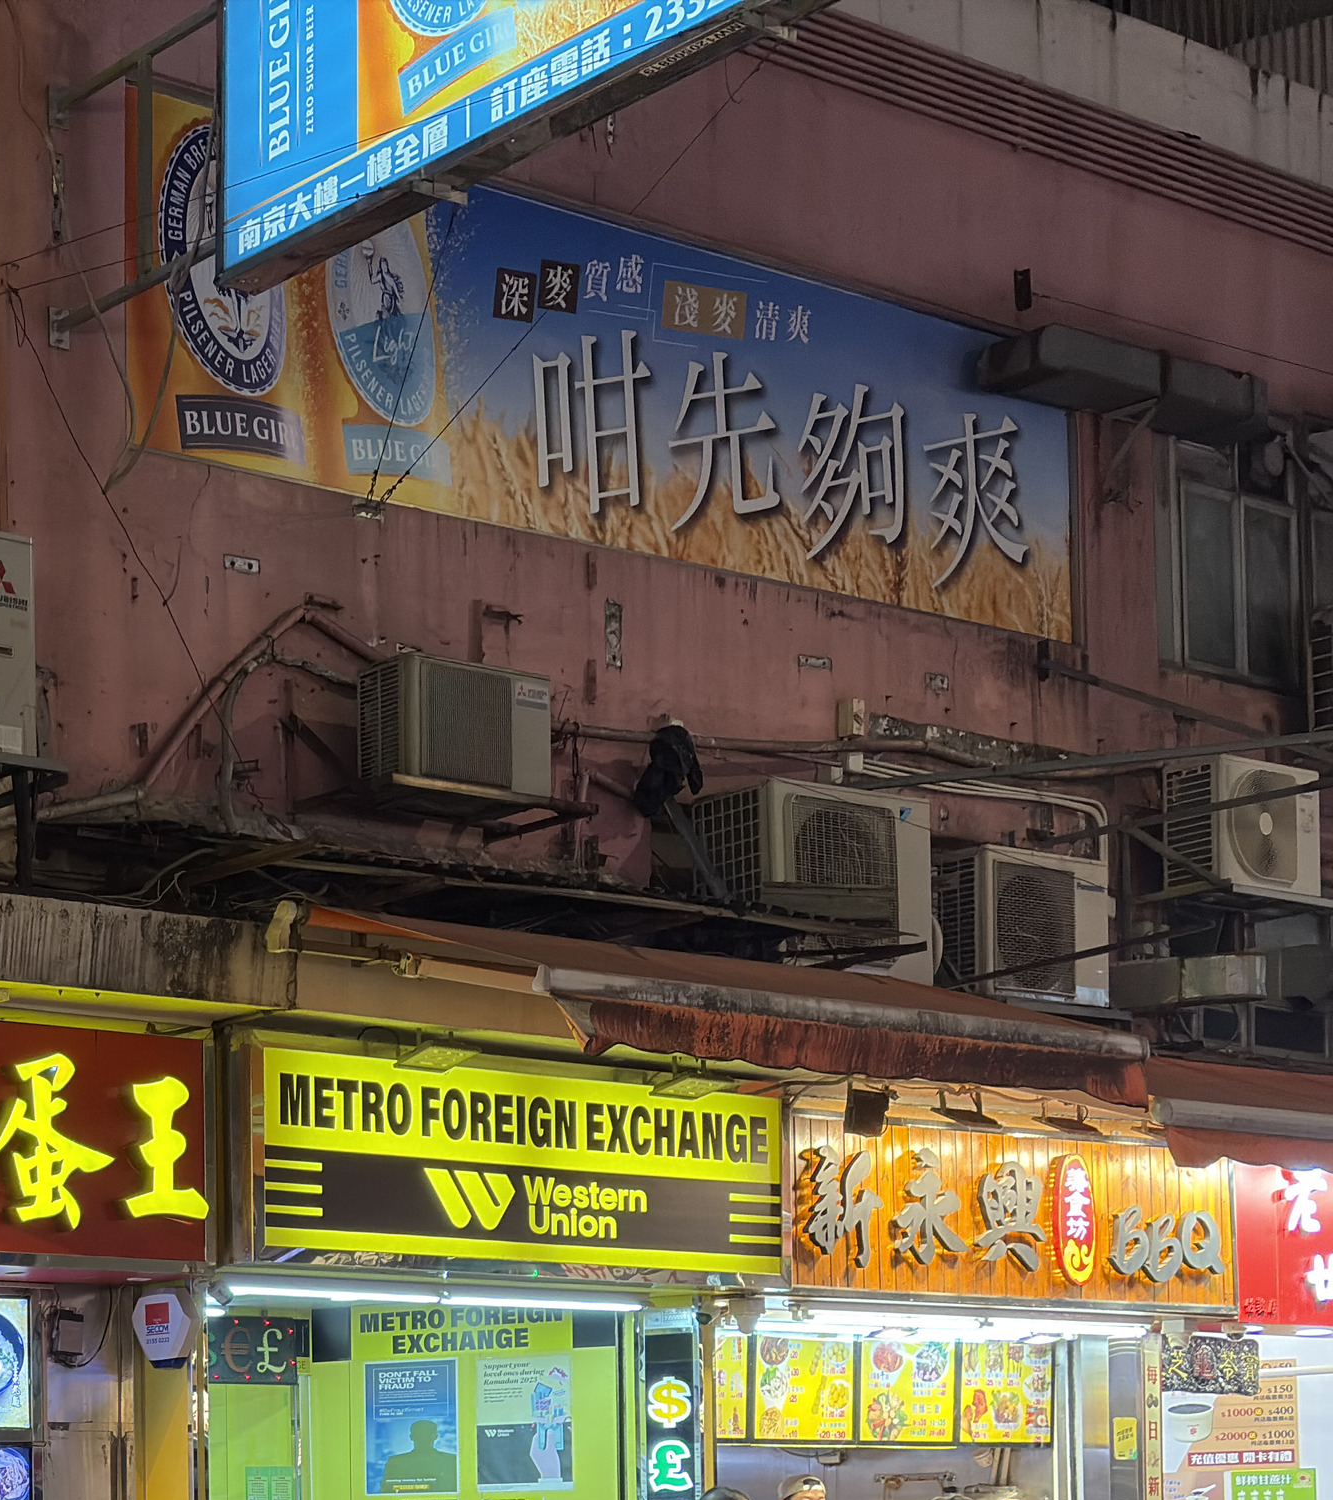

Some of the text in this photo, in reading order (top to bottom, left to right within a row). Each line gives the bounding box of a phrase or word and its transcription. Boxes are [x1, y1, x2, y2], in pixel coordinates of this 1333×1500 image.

[304, 4, 315, 135] ZERO SUGAR BEER
[407, 42, 467, 100] BLUE
[269, 52, 290, 162] BLUE
[167, 171, 188, 242] GERMAN
[178, 289, 236, 378] PILSENER
[184, 409, 250, 439] BLUE
[351, 437, 408, 464] BLUE
[532, 328, 1030, 589] 咁先夠爽
[278, 1072, 769, 1164] METRO FOREIGN EXCHANGE
[523, 1174, 648, 1214] Western
[800, 1144, 1048, 1273] 新永興
[529, 1205, 618, 1240] Union
[1107, 1204, 1225, 1284] BBQ
[146, 1325, 170, 1335] SECOM
[359, 1307, 564, 1333] METRO FOREIGN
[392, 1328, 530, 1355] EXCHANGE
[378, 1369, 439, 1379] DON'T FALL
[484, 1361, 531, 1371] Support your
[484, 1370, 502, 1378] loved
[519, 1368, 546, 1378] during
[378, 1375, 432, 1385] VICTIM TO
[378, 1382, 415, 1391] FRAUD
[484, 1377, 520, 1386] Ramadan
[1267, 1384, 1293, 1394] $150
[1220, 1406, 1295, 1417] $1000 $400
[1214, 1429, 1295, 1441] $2000 $1000
